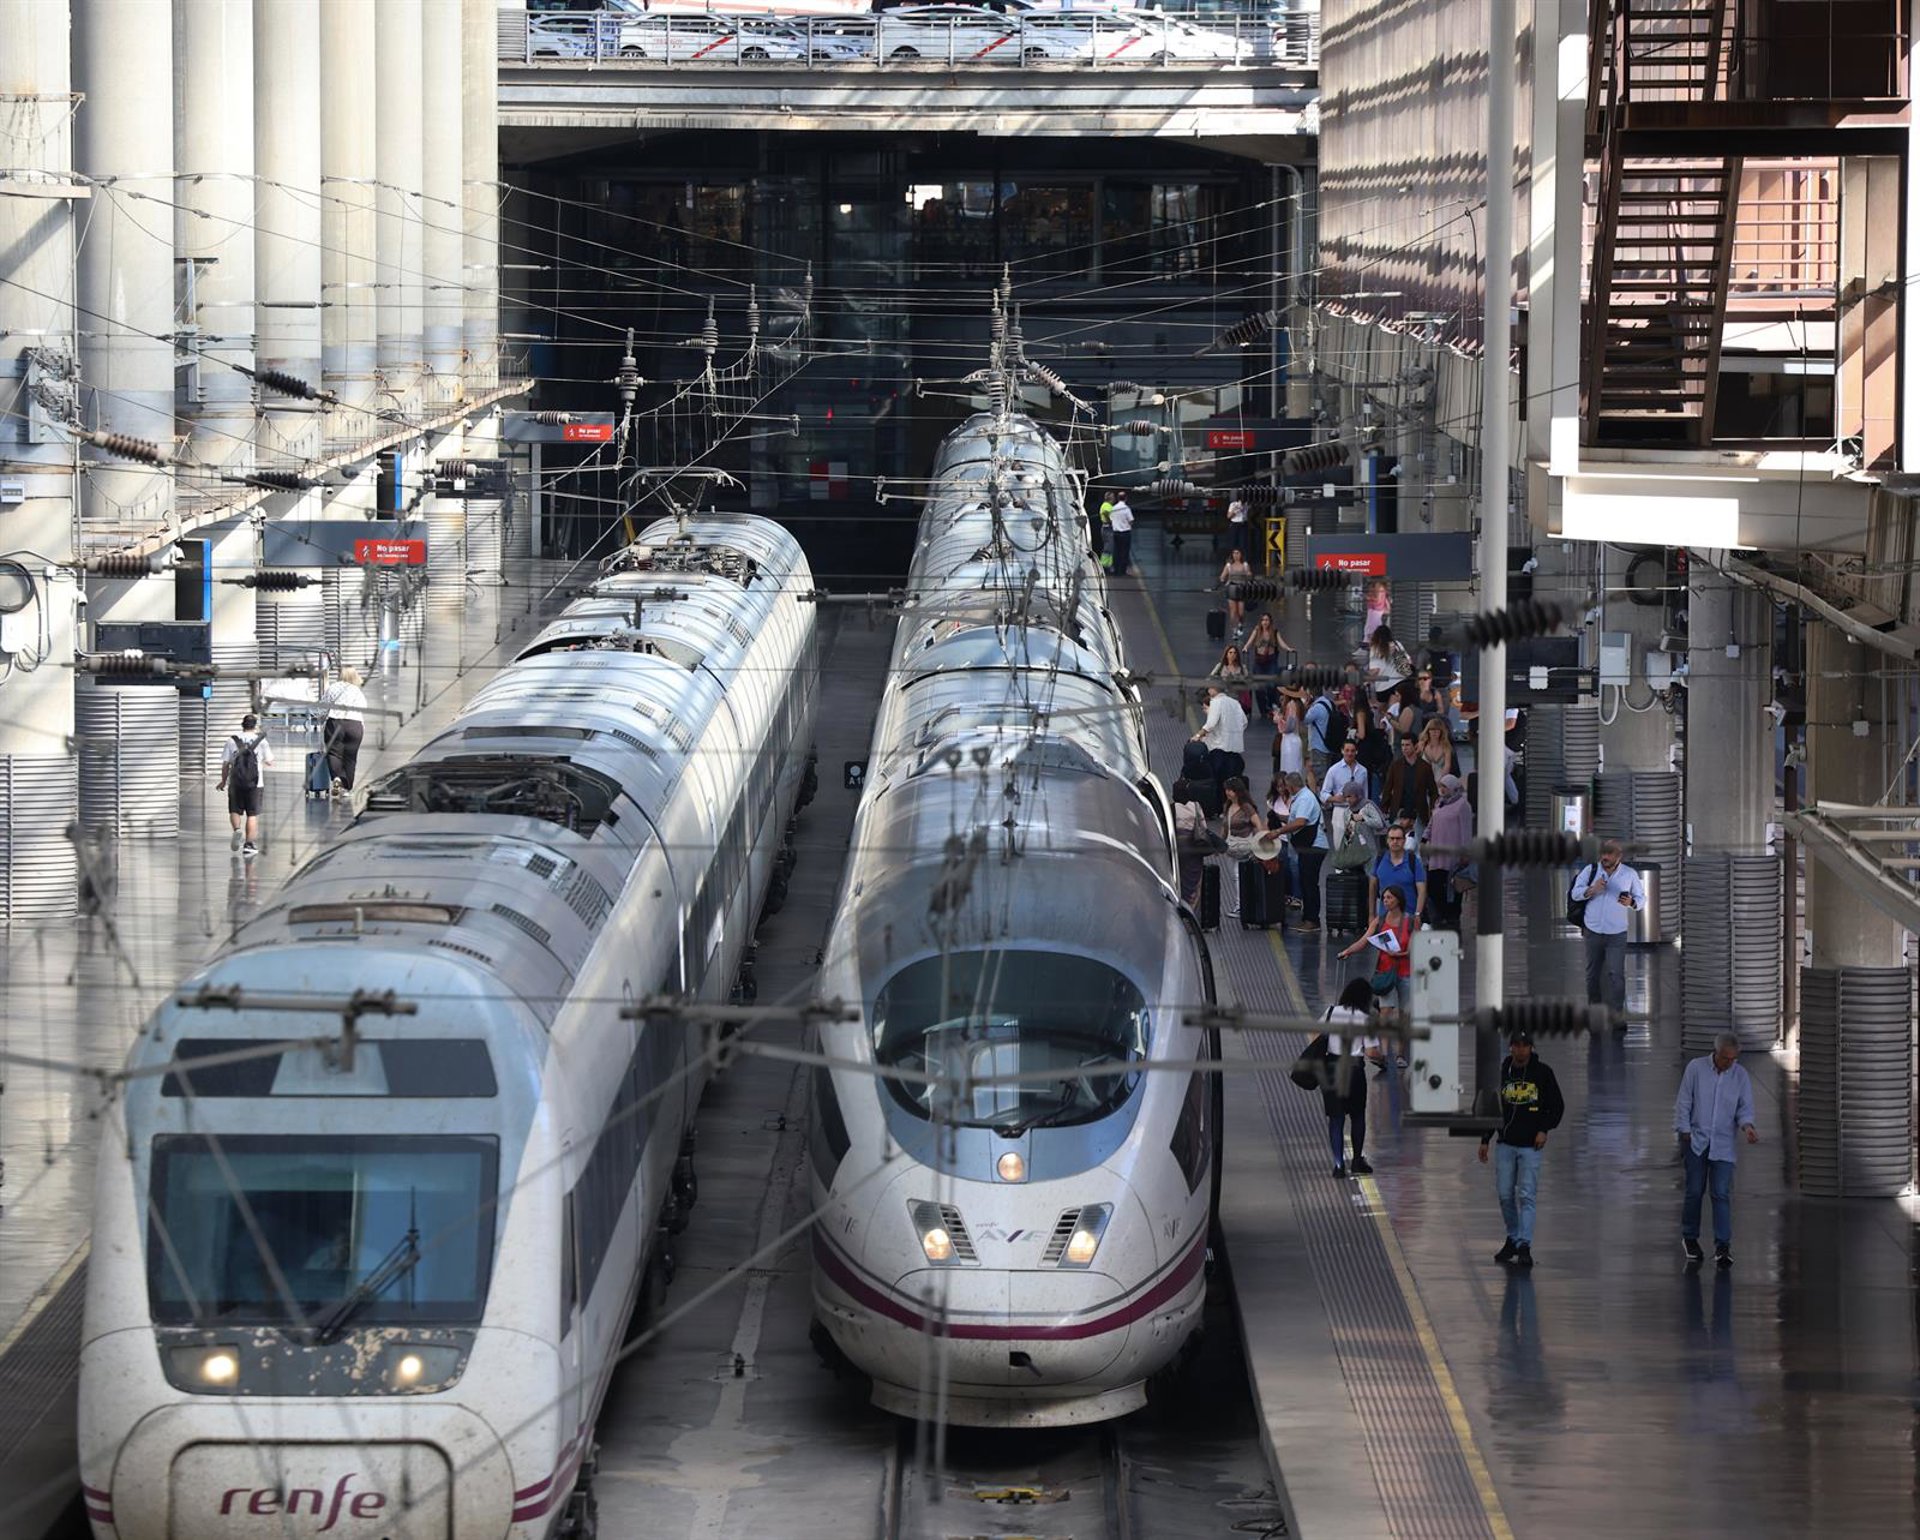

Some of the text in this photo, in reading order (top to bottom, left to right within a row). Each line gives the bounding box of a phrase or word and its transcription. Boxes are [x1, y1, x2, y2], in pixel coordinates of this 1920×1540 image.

[376, 544, 410, 553] No pasar
[1338, 559, 1371, 568] No pasar
[219, 1472, 387, 1533] renfe
